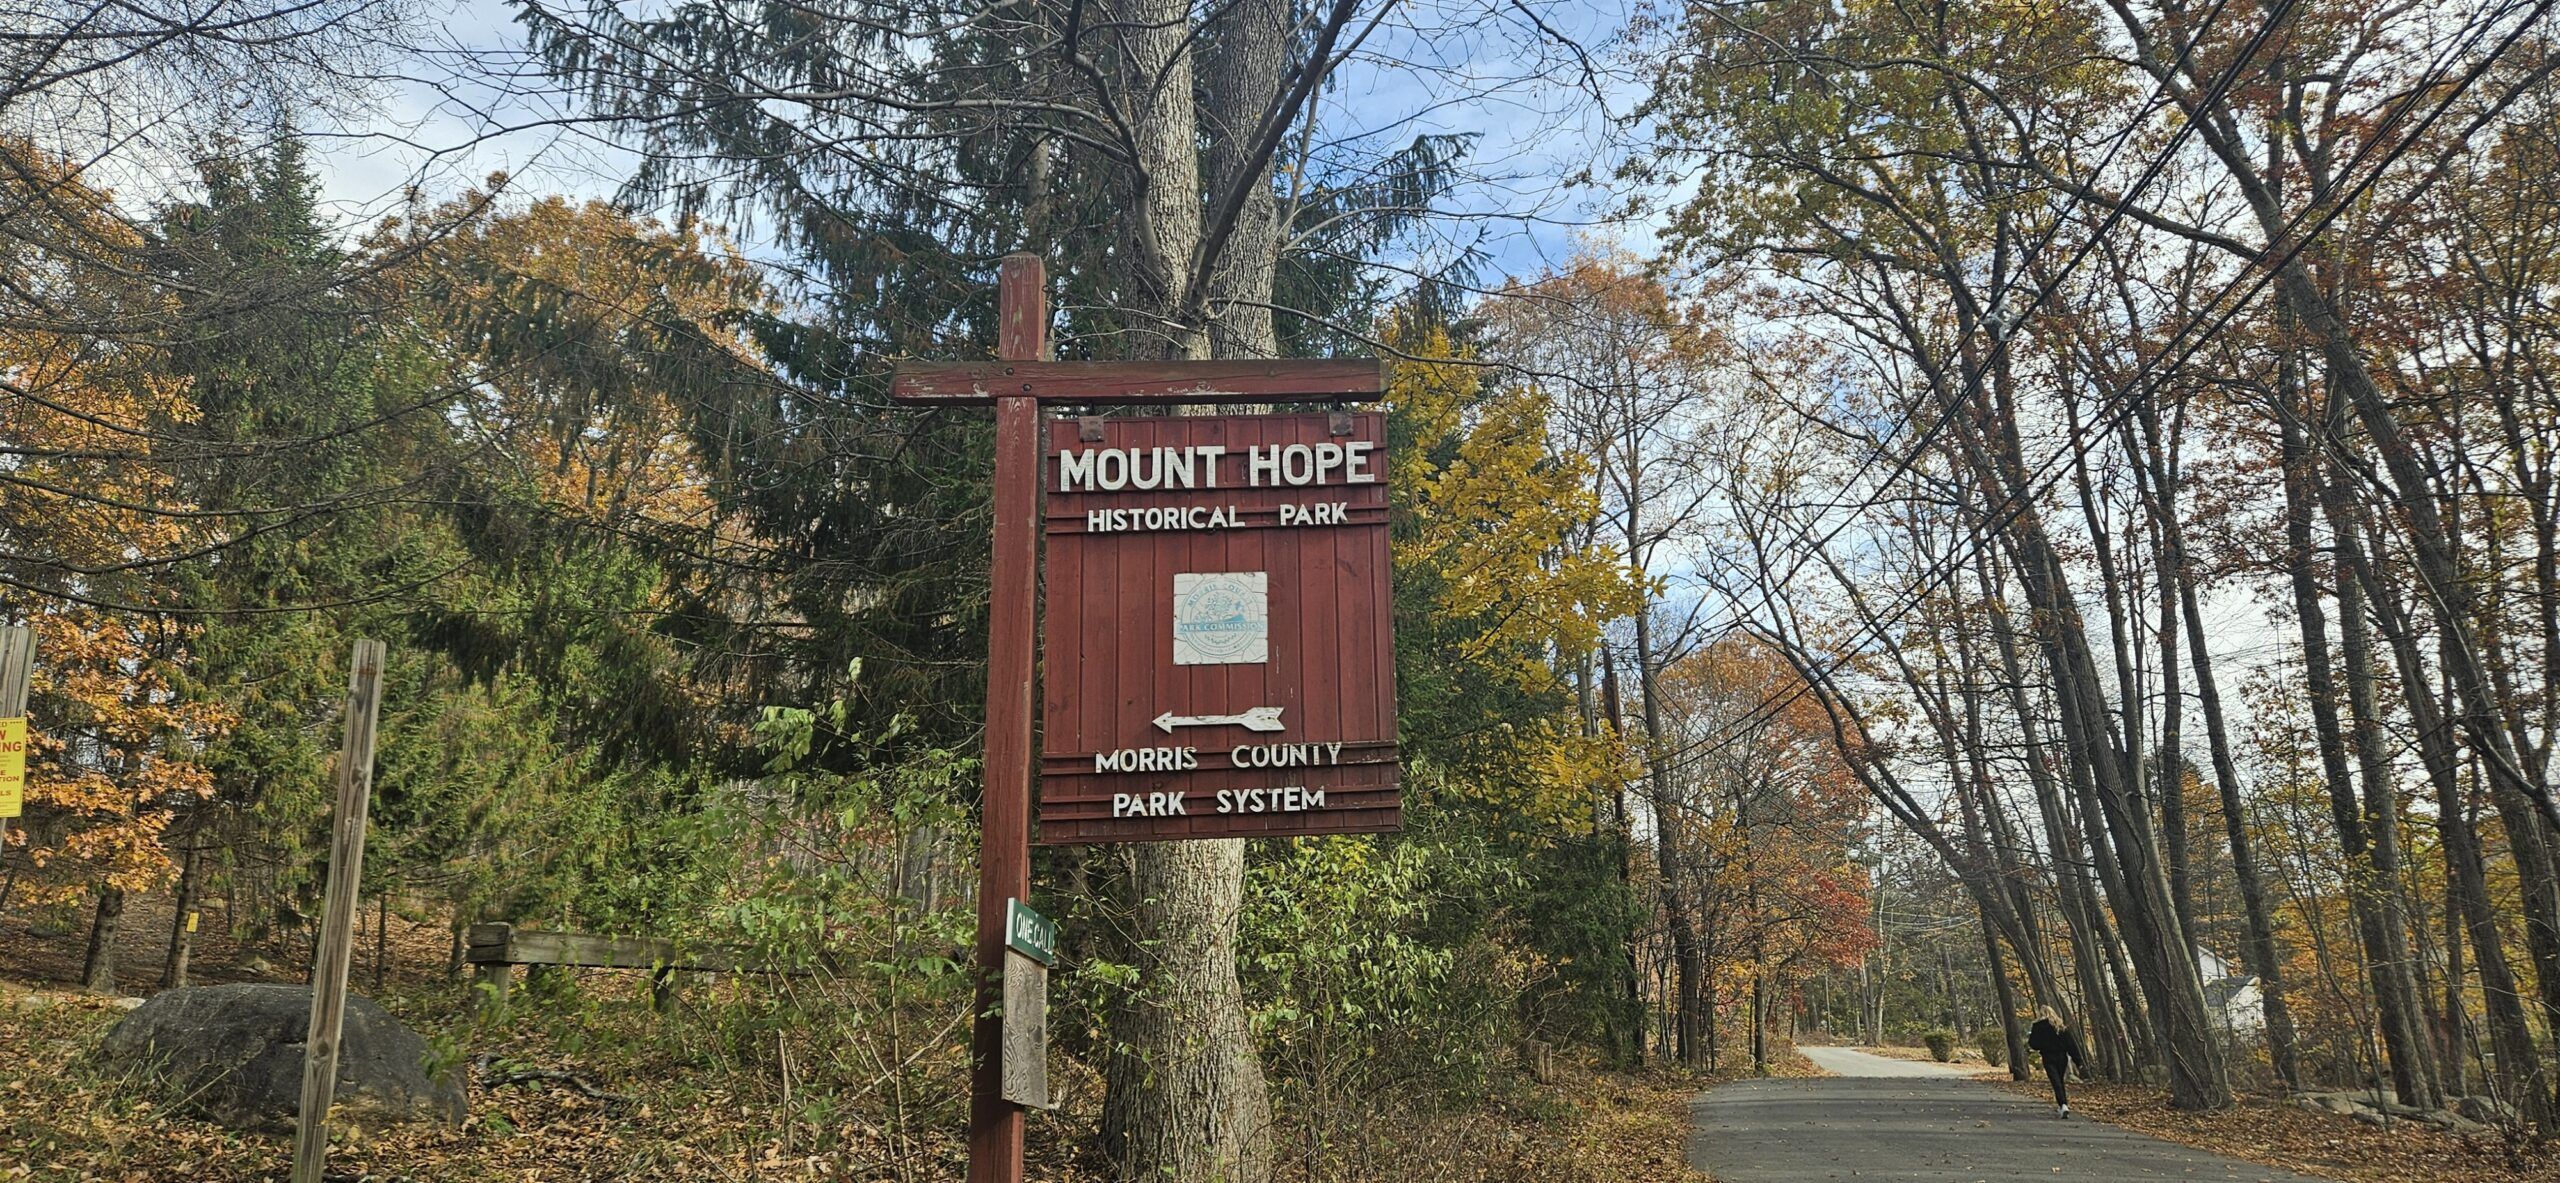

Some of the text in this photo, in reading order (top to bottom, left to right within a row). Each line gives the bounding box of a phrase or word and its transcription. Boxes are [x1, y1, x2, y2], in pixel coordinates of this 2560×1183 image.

[1060, 441, 1375, 492] MOUNT HOPE
[1087, 502, 1348, 532] HISTORICAL PARK
[0, 741, 22, 752] NG
[1095, 741, 1342, 773] MORRIS COUNTY
[1113, 785, 1325, 818] PARK SYSTEM
[1016, 912, 1053, 956] ONE CALL
